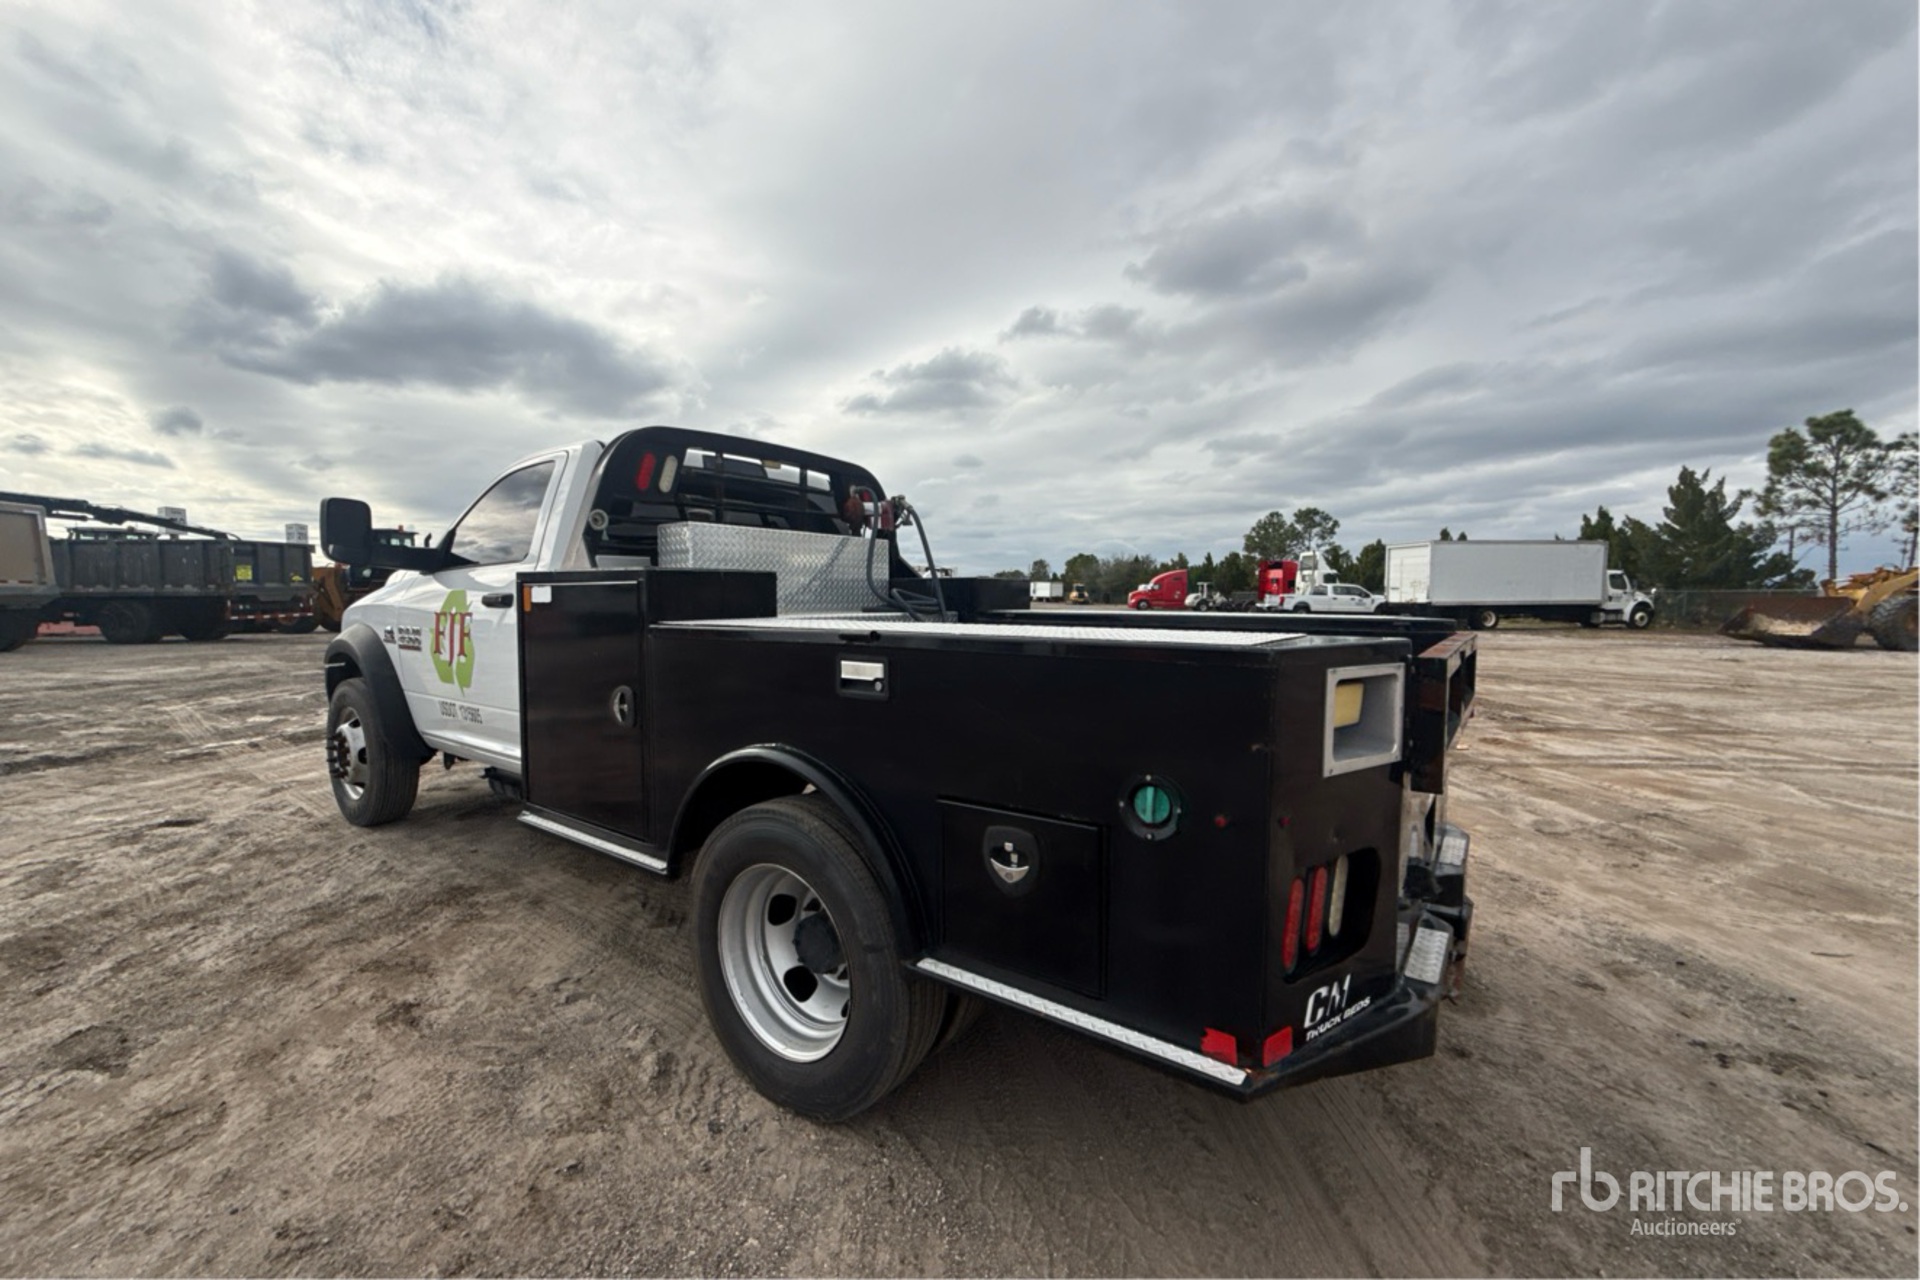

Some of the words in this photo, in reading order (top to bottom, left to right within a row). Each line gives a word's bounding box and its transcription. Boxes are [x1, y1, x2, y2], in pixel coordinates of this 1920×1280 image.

[434, 612, 473, 666] FJF
[440, 701, 458, 718] USDOT
[1303, 973, 1351, 1028] CM
[1305, 1013, 1342, 1041] TRUCK
[1342, 995, 1371, 1020] BEDS
